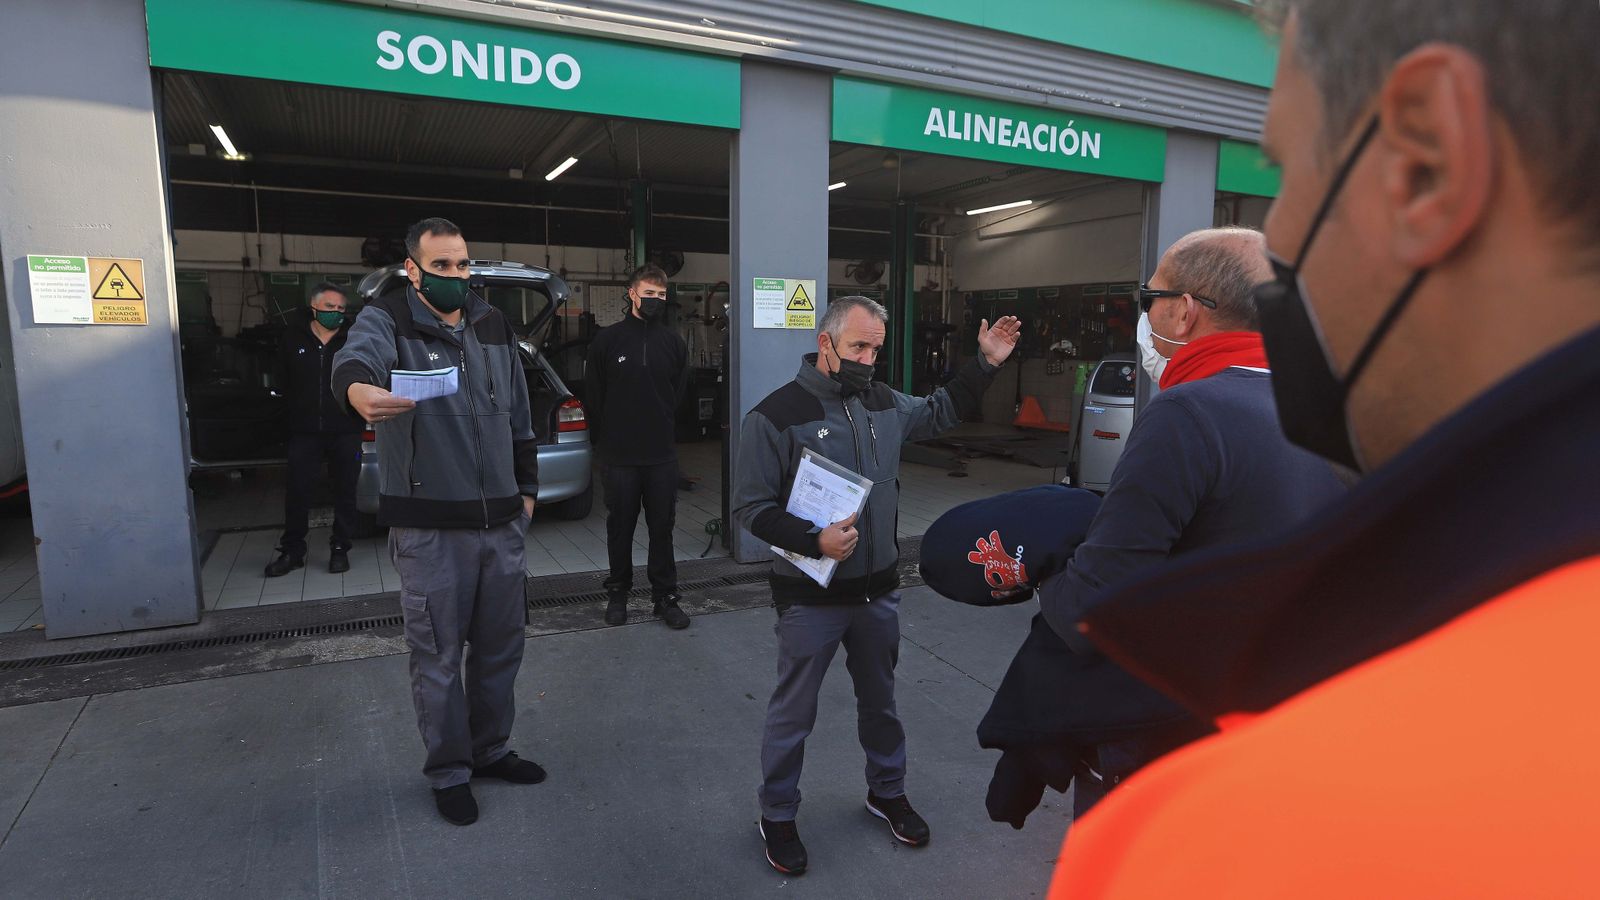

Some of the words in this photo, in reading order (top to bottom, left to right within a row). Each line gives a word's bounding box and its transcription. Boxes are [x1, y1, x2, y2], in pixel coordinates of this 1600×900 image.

[376, 30, 582, 90] SONIDO
[924, 107, 1102, 159] ALINEACIÓN
[47, 264, 82, 272] permitido
